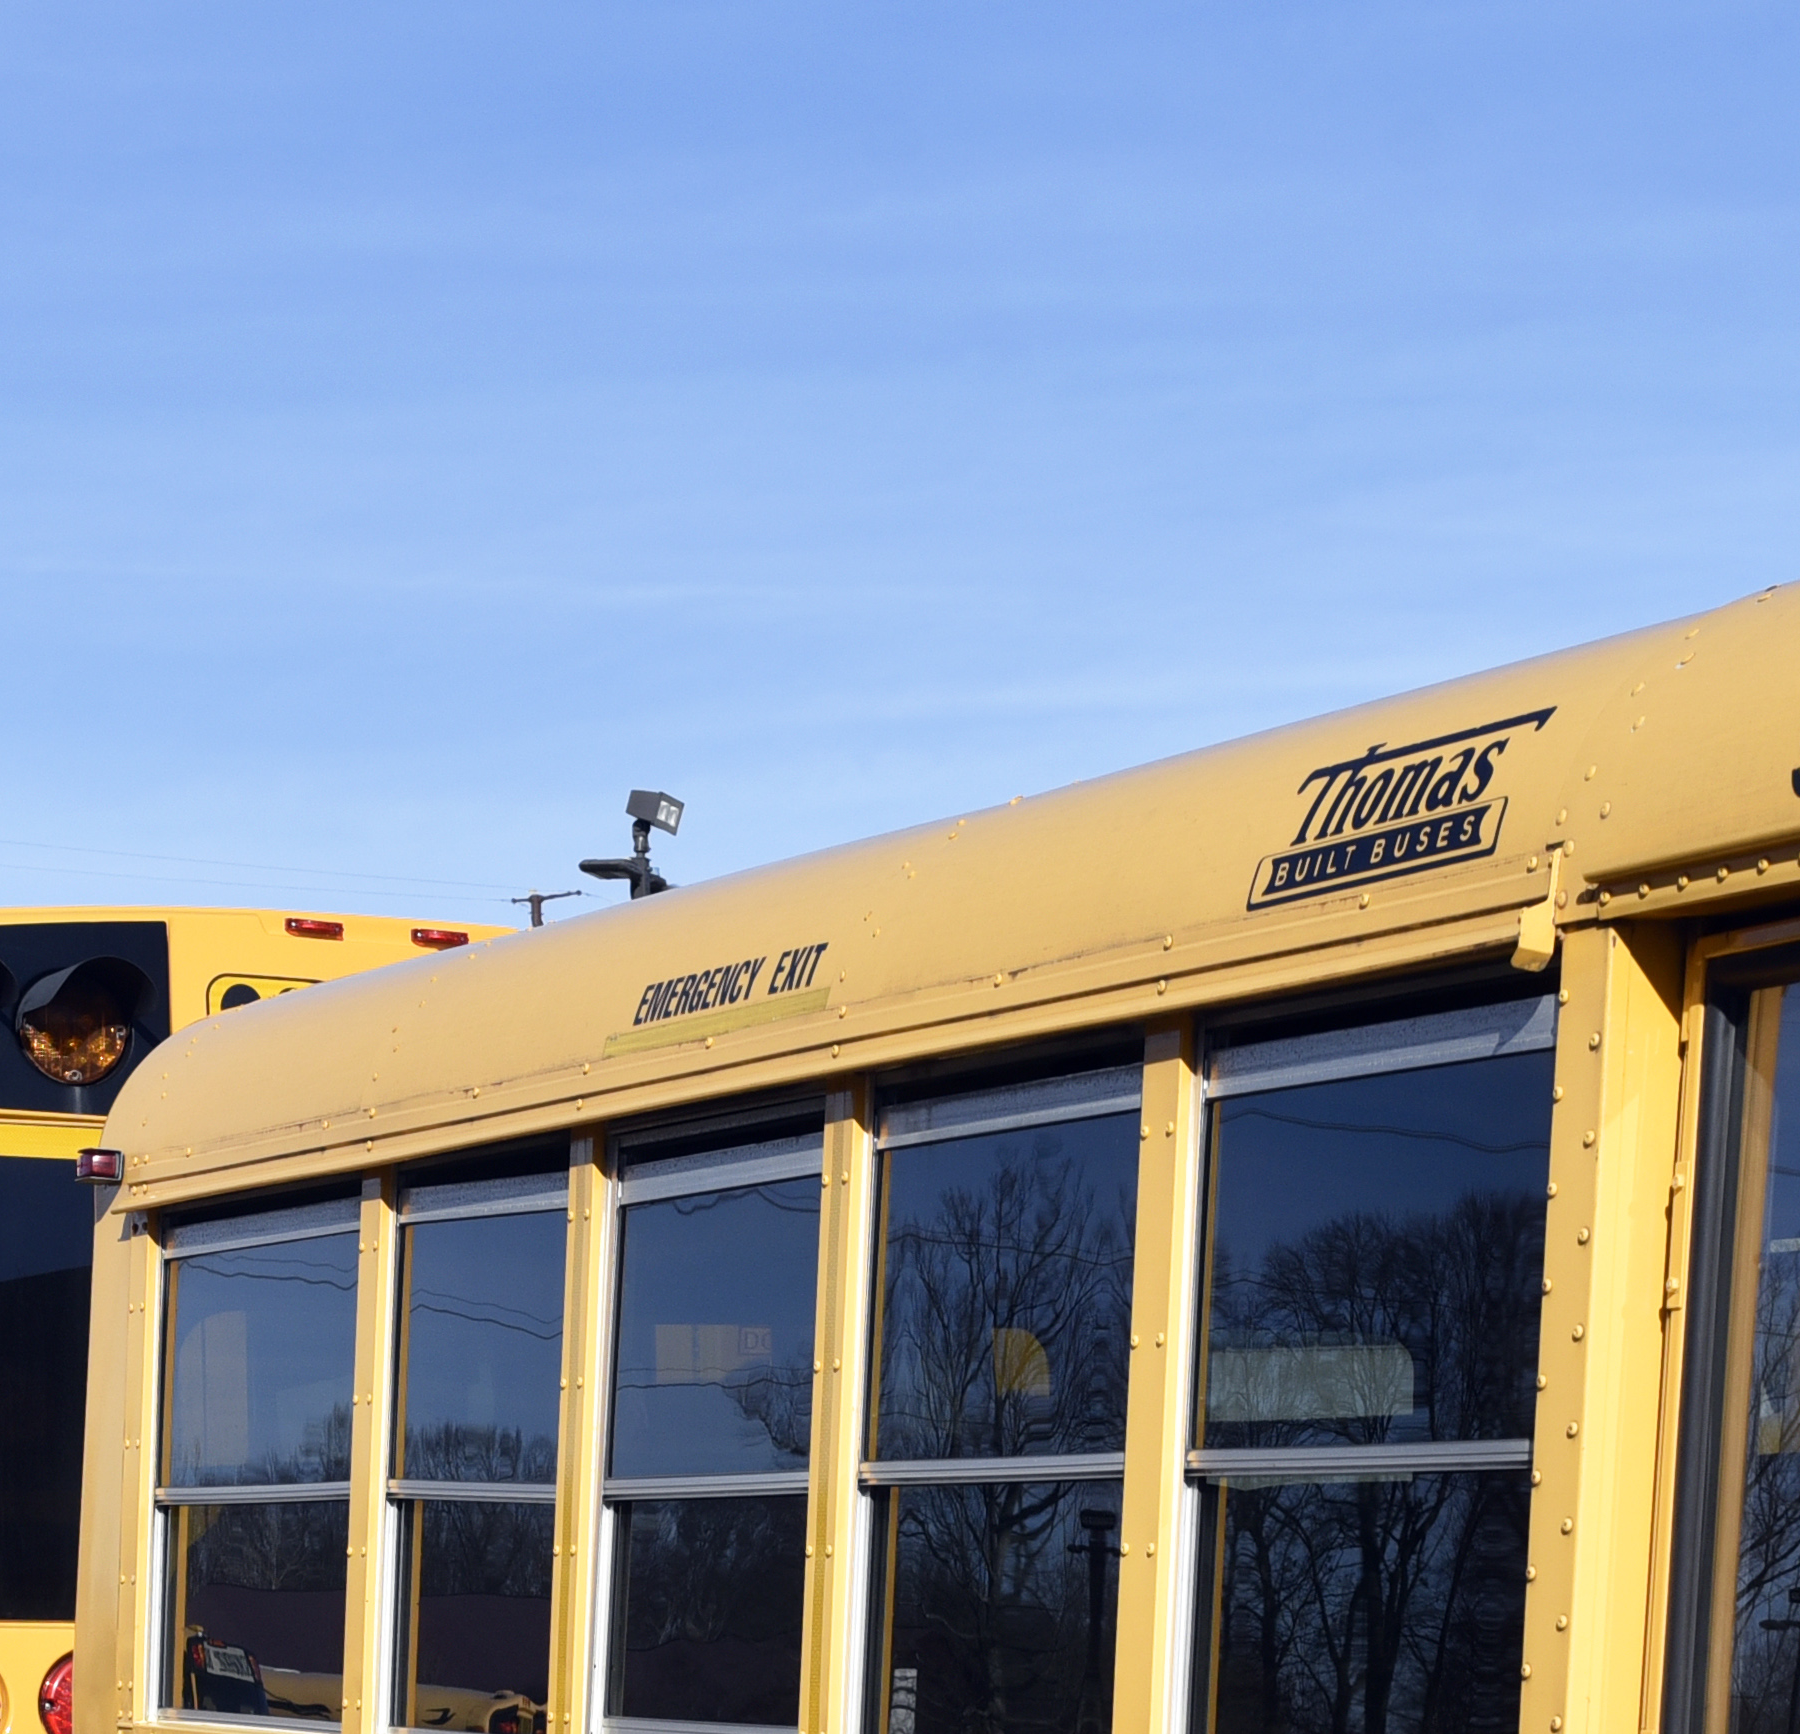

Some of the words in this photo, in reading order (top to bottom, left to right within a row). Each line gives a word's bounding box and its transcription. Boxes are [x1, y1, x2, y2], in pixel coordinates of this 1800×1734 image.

[1290, 705, 1558, 846] Thomas
[1273, 843, 1354, 886] BUILT
[1371, 813, 1474, 862] BUSES
[633, 955, 767, 1026] EMERGENCY
[767, 942, 829, 995] EXIT
